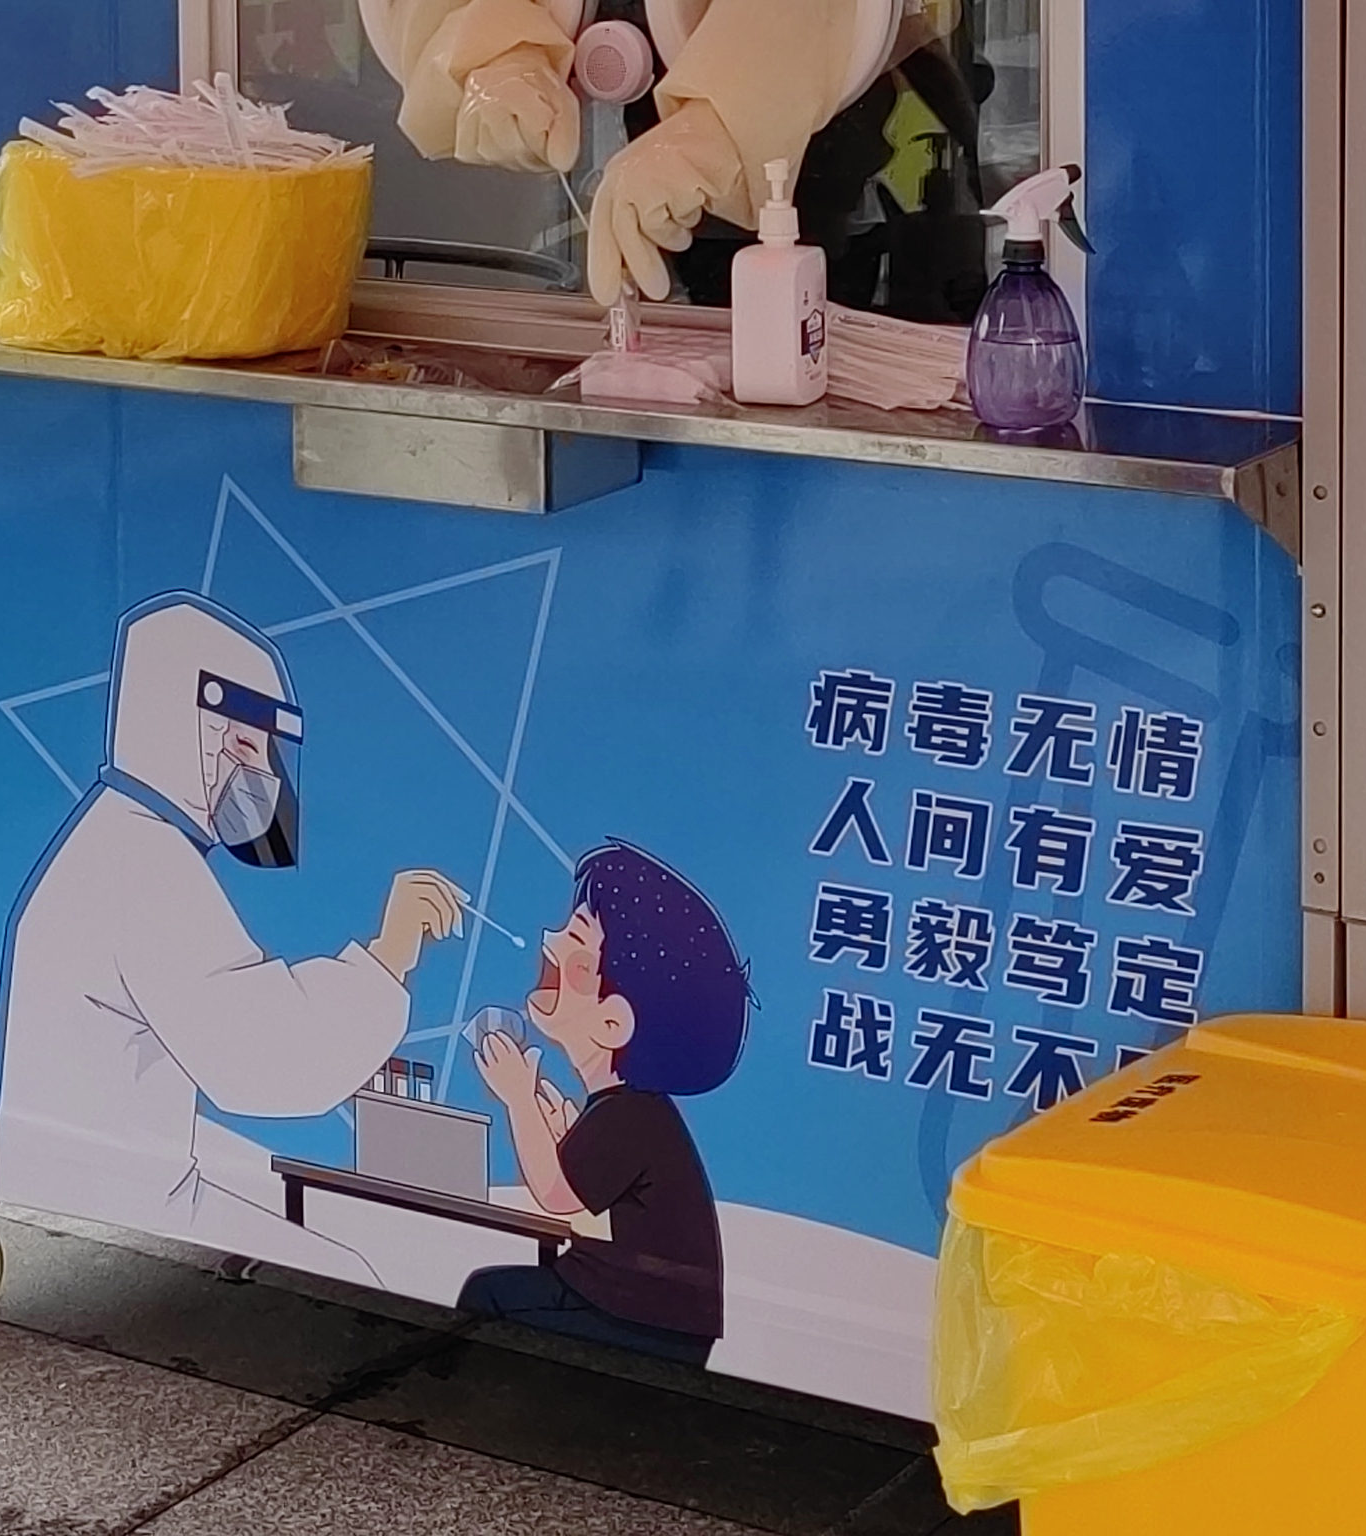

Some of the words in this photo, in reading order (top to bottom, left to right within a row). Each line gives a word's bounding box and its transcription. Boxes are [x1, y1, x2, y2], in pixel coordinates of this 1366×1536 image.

[805, 668, 1204, 801] 病毒无情
[809, 775, 1204, 917] 人间有爱
[809, 880, 1204, 1027] 勇毅笃定
[808, 987, 1159, 1112] 战无不
